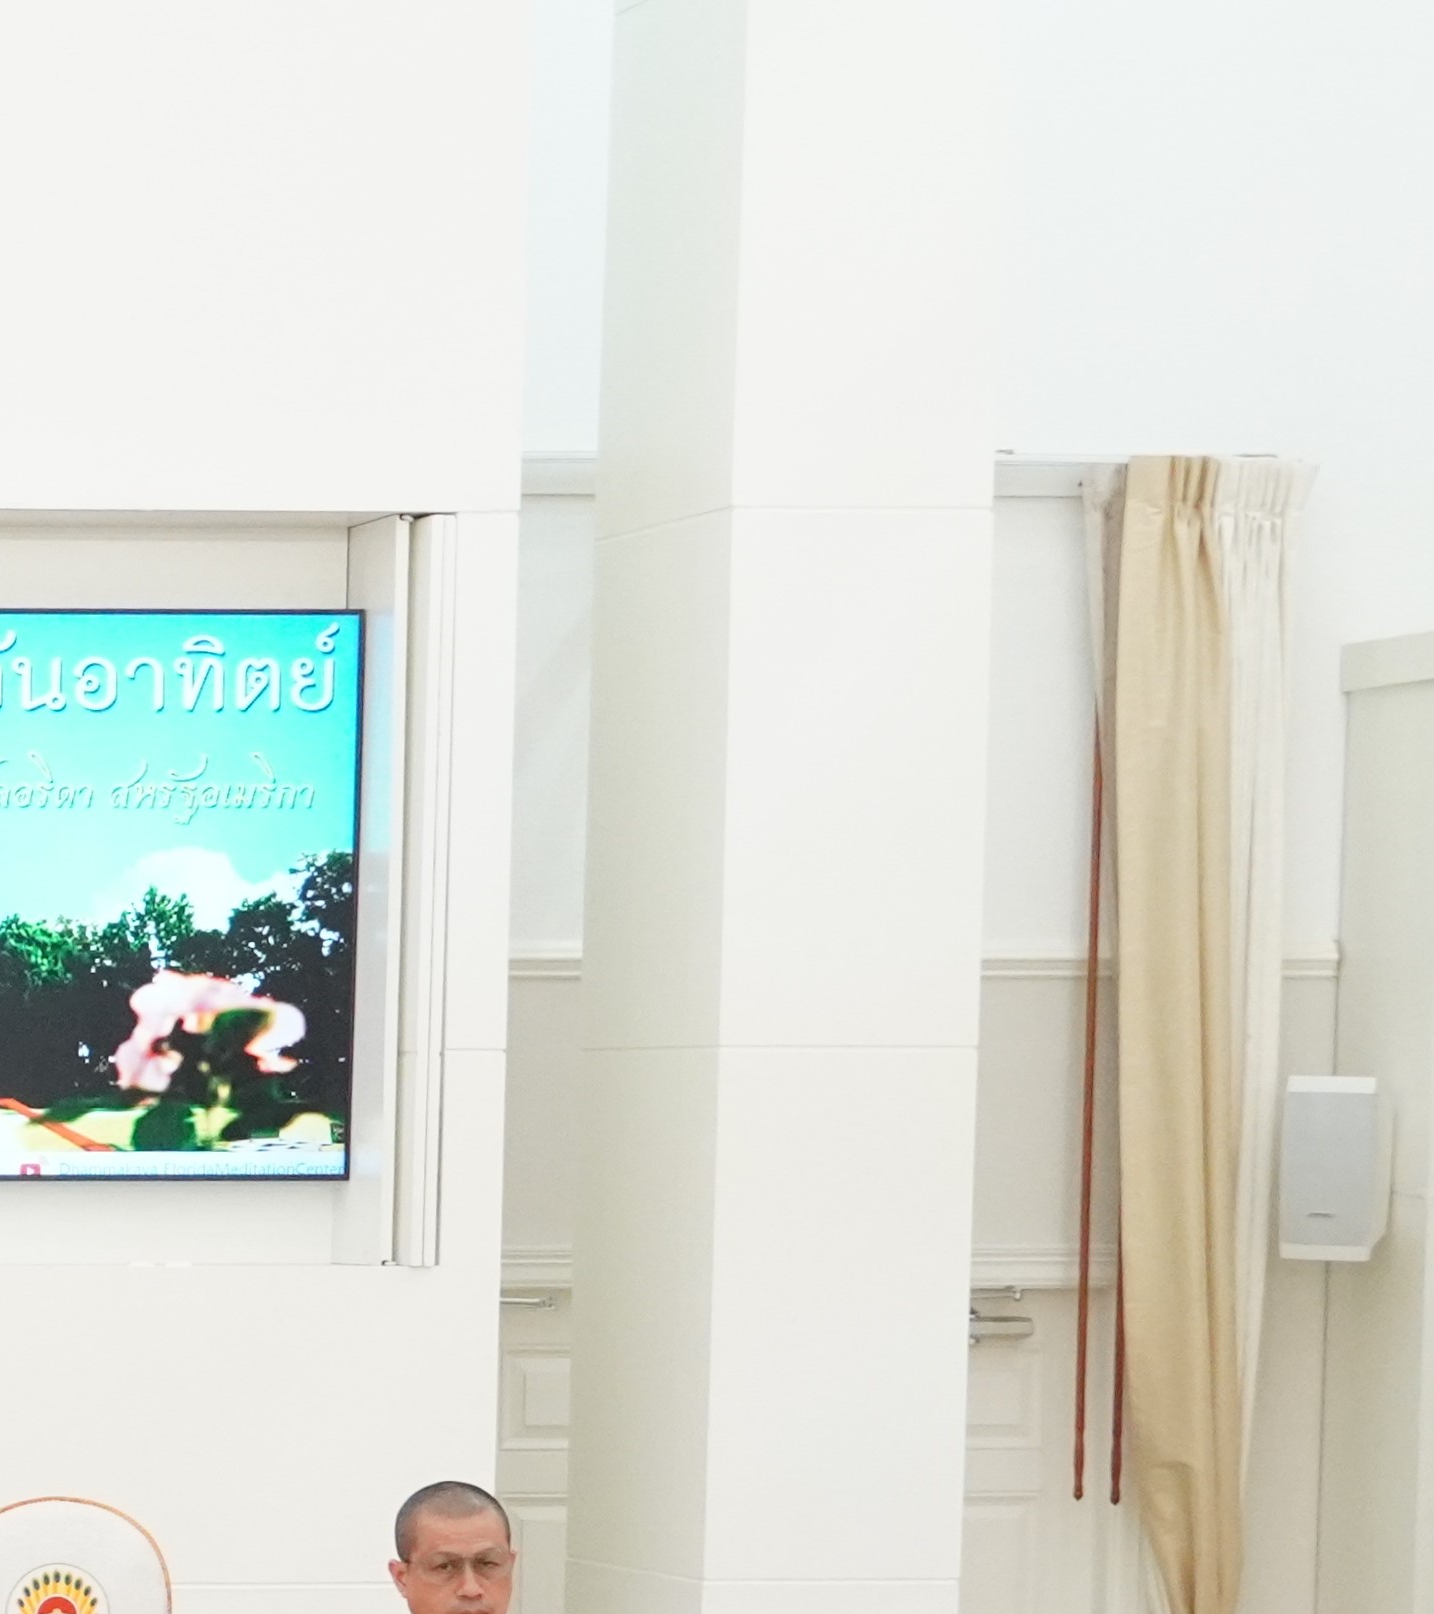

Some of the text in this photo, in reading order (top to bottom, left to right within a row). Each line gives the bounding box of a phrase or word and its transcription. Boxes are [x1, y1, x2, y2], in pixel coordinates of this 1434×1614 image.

[109, 751, 316, 826] สหรัฐอเมริกา
